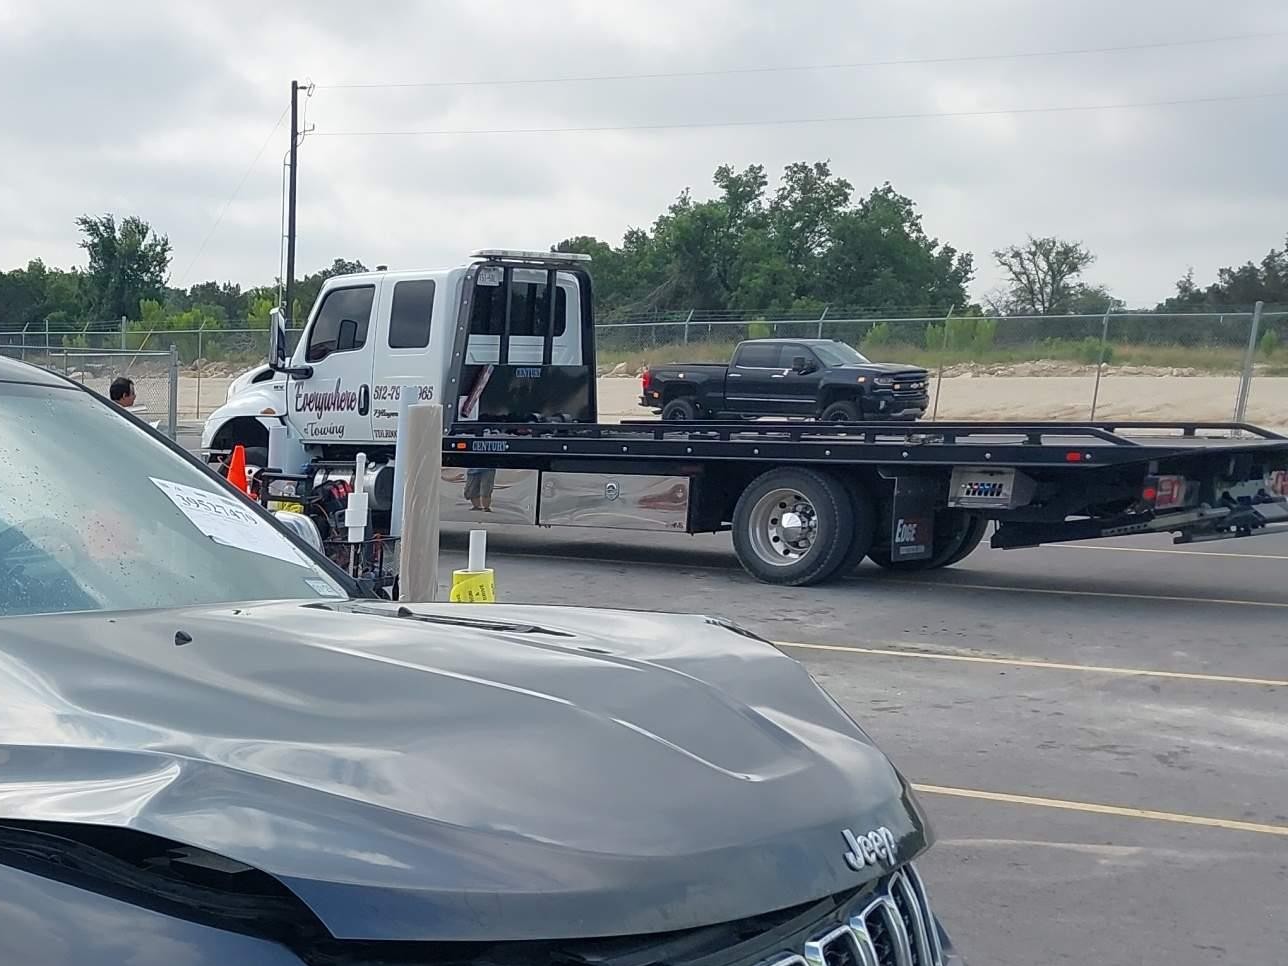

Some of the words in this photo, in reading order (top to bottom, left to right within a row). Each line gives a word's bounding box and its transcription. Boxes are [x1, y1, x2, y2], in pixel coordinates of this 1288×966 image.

[515, 367, 541, 378] CENTURY
[295, 377, 357, 420] Everywhere
[305, 421, 345, 438] Towing
[472, 440, 507, 452] CENTURY
[840, 826, 896, 870] Jeep
